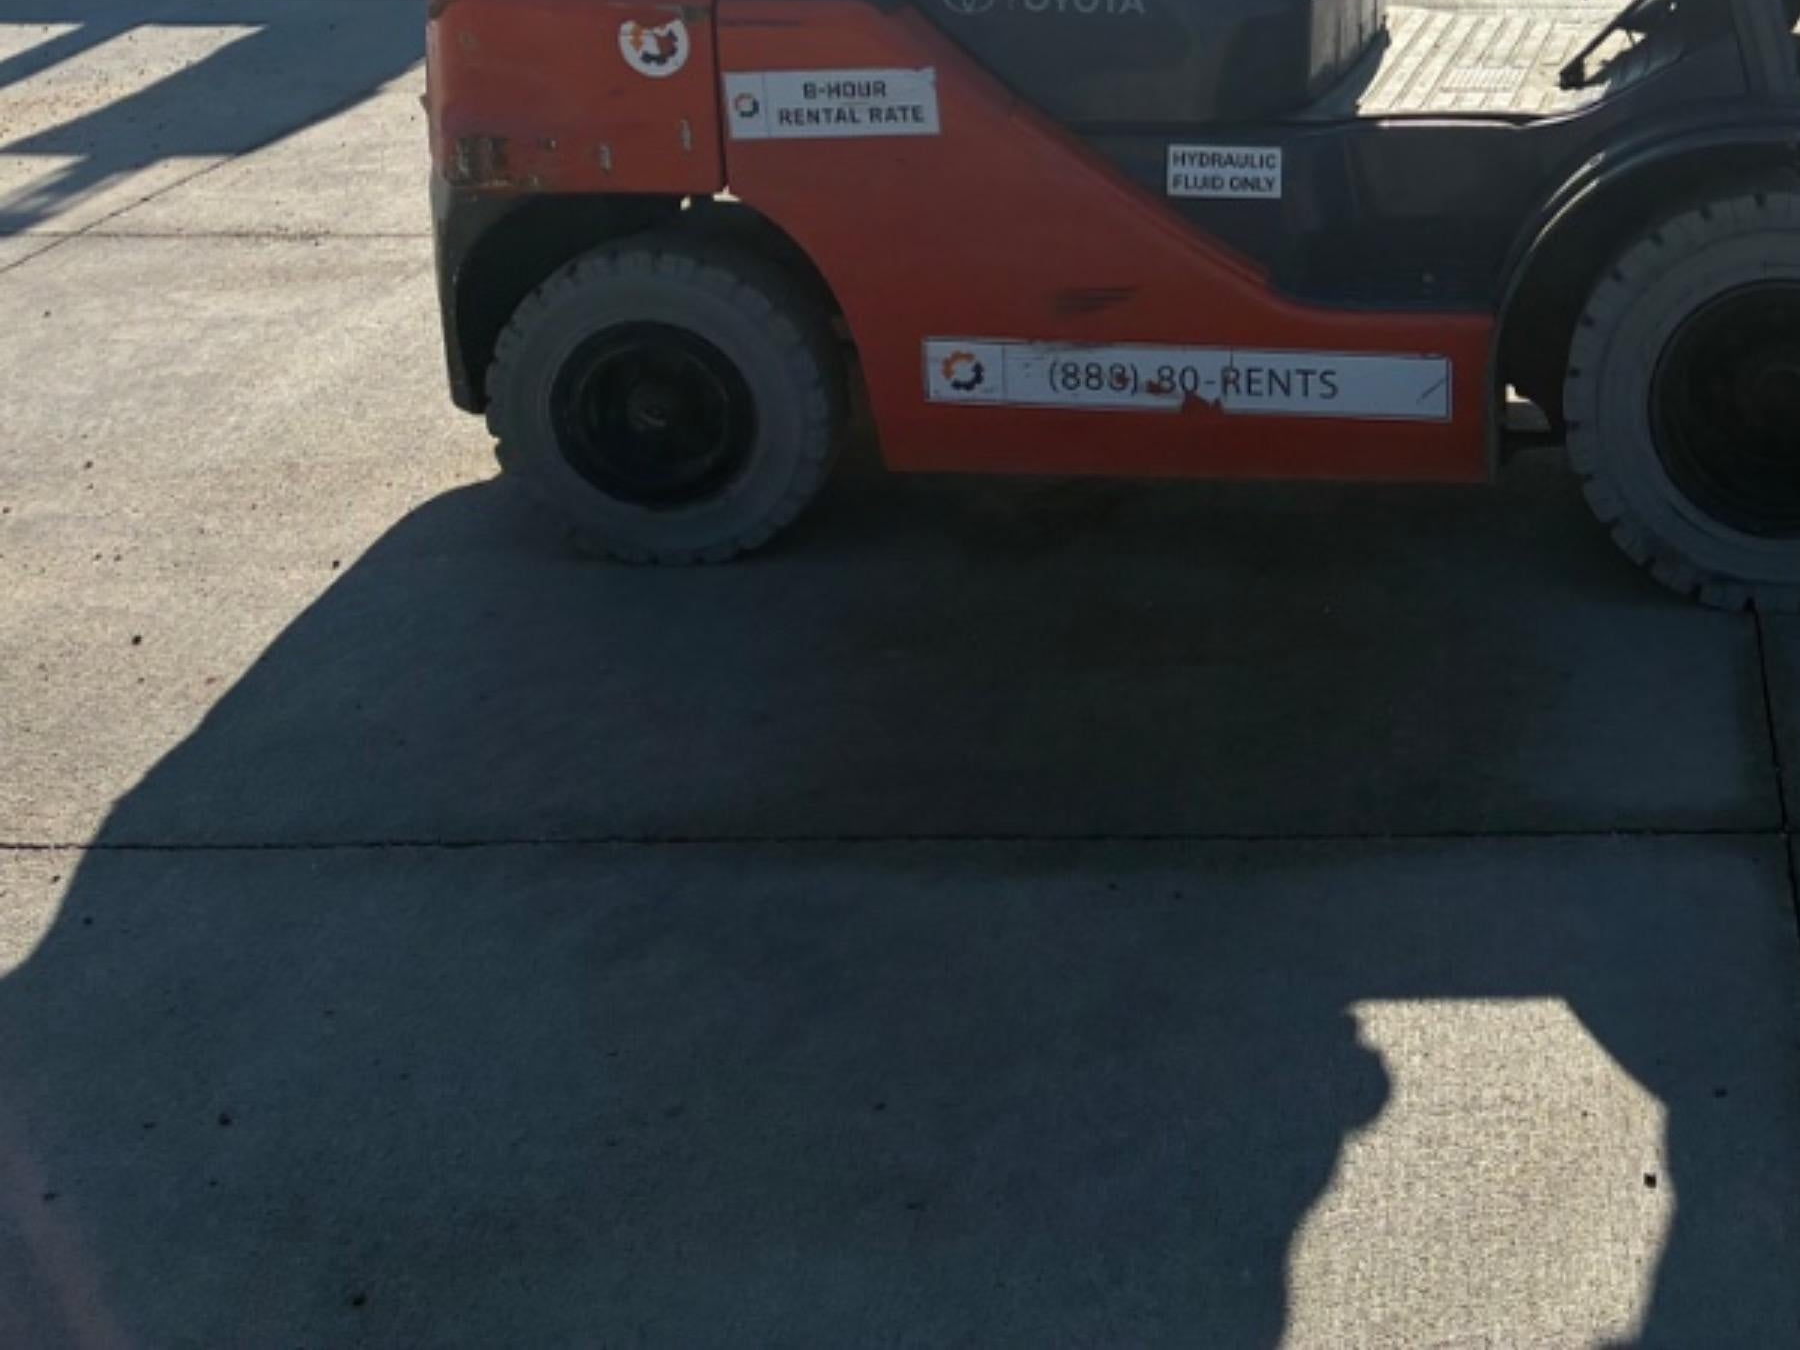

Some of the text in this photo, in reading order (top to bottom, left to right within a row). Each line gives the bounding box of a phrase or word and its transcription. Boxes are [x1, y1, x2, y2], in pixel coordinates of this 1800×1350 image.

[778, 104, 926, 127] RENTAL RATE
[1173, 151, 1279, 170] HYDRAULIC
[1172, 173, 1276, 193] FLUID ONLY
